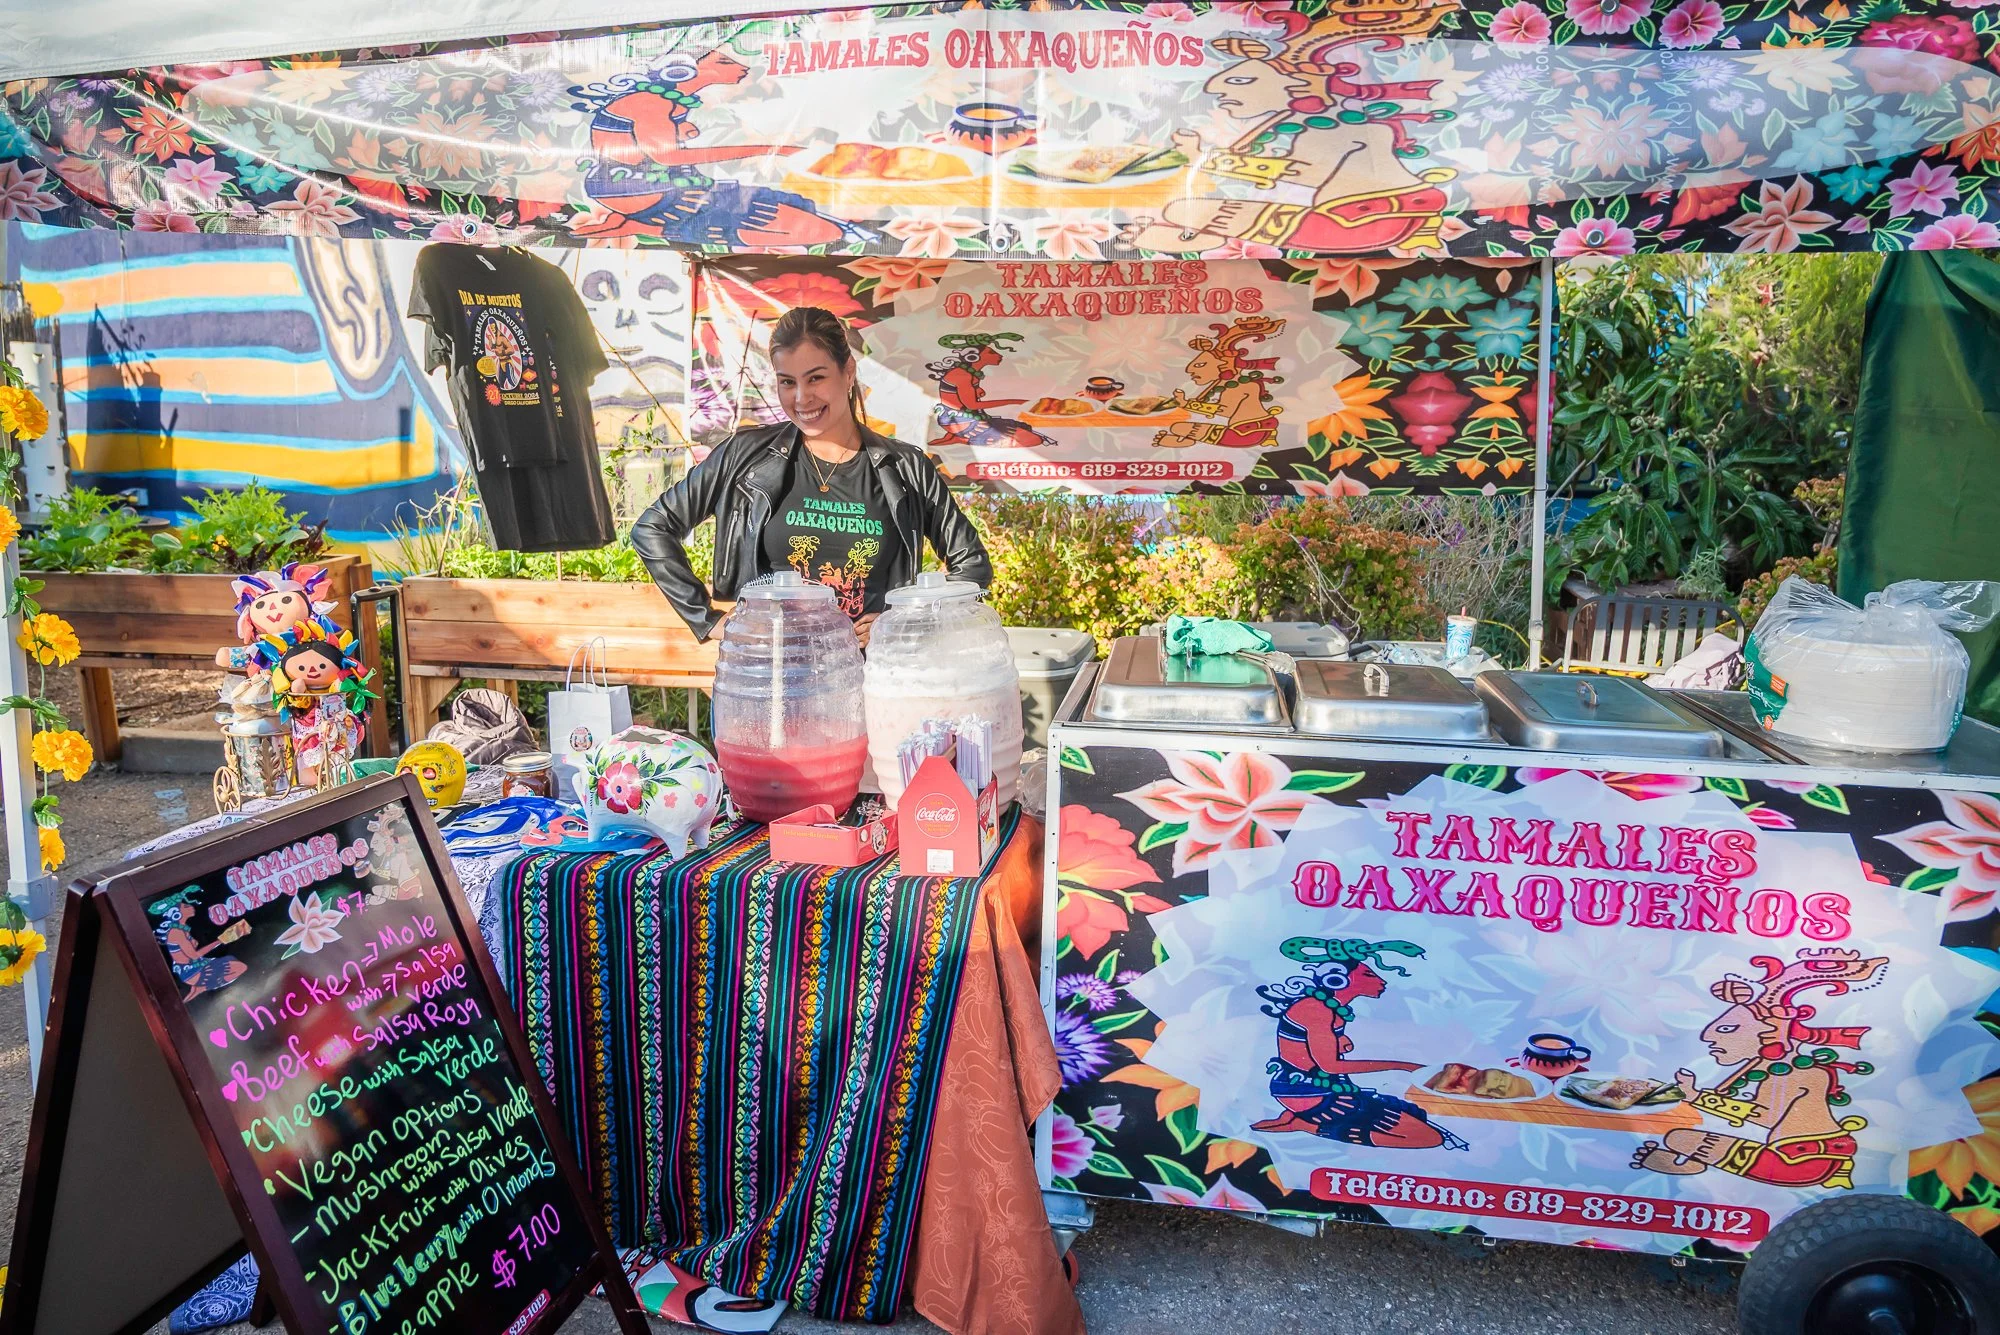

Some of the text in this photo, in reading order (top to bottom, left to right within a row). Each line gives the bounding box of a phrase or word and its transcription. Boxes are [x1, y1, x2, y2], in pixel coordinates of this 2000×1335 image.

[763, 20, 1205, 76] TAMALES OAXAQUEÑOS
[458, 289, 523, 308] DIA DE MUERTOS
[944, 281, 1264, 320] OAXAQUEÑOS
[997, 259, 1208, 288] TAMALES
[475, 309, 490, 344] TAMALES
[974, 461, 1224, 478] Teléfono: 619-829-1012
[785, 510, 883, 536] OAXAQUEÑOS
[802, 496, 866, 515] TAMALES
[228, 834, 338, 890] TAMALES
[1387, 811, 1759, 883] TAMALES
[1292, 859, 1854, 940] OAXAQUEÑOS
[226, 915, 438, 1041] Chicken Mole
[346, 986, 383, 1012] with
[231, 1035, 311, 1102] Beef
[251, 1076, 362, 1152] Cheese
[363, 1060, 404, 1090] with
[276, 1130, 388, 1201] Vegan
[402, 1160, 444, 1193] with
[442, 1176, 470, 1205] with
[469, 1135, 530, 1184] Olives
[1325, 1171, 1752, 1236] Teléfono: 619-829-1012
[394, 1262, 480, 1335] eapple
